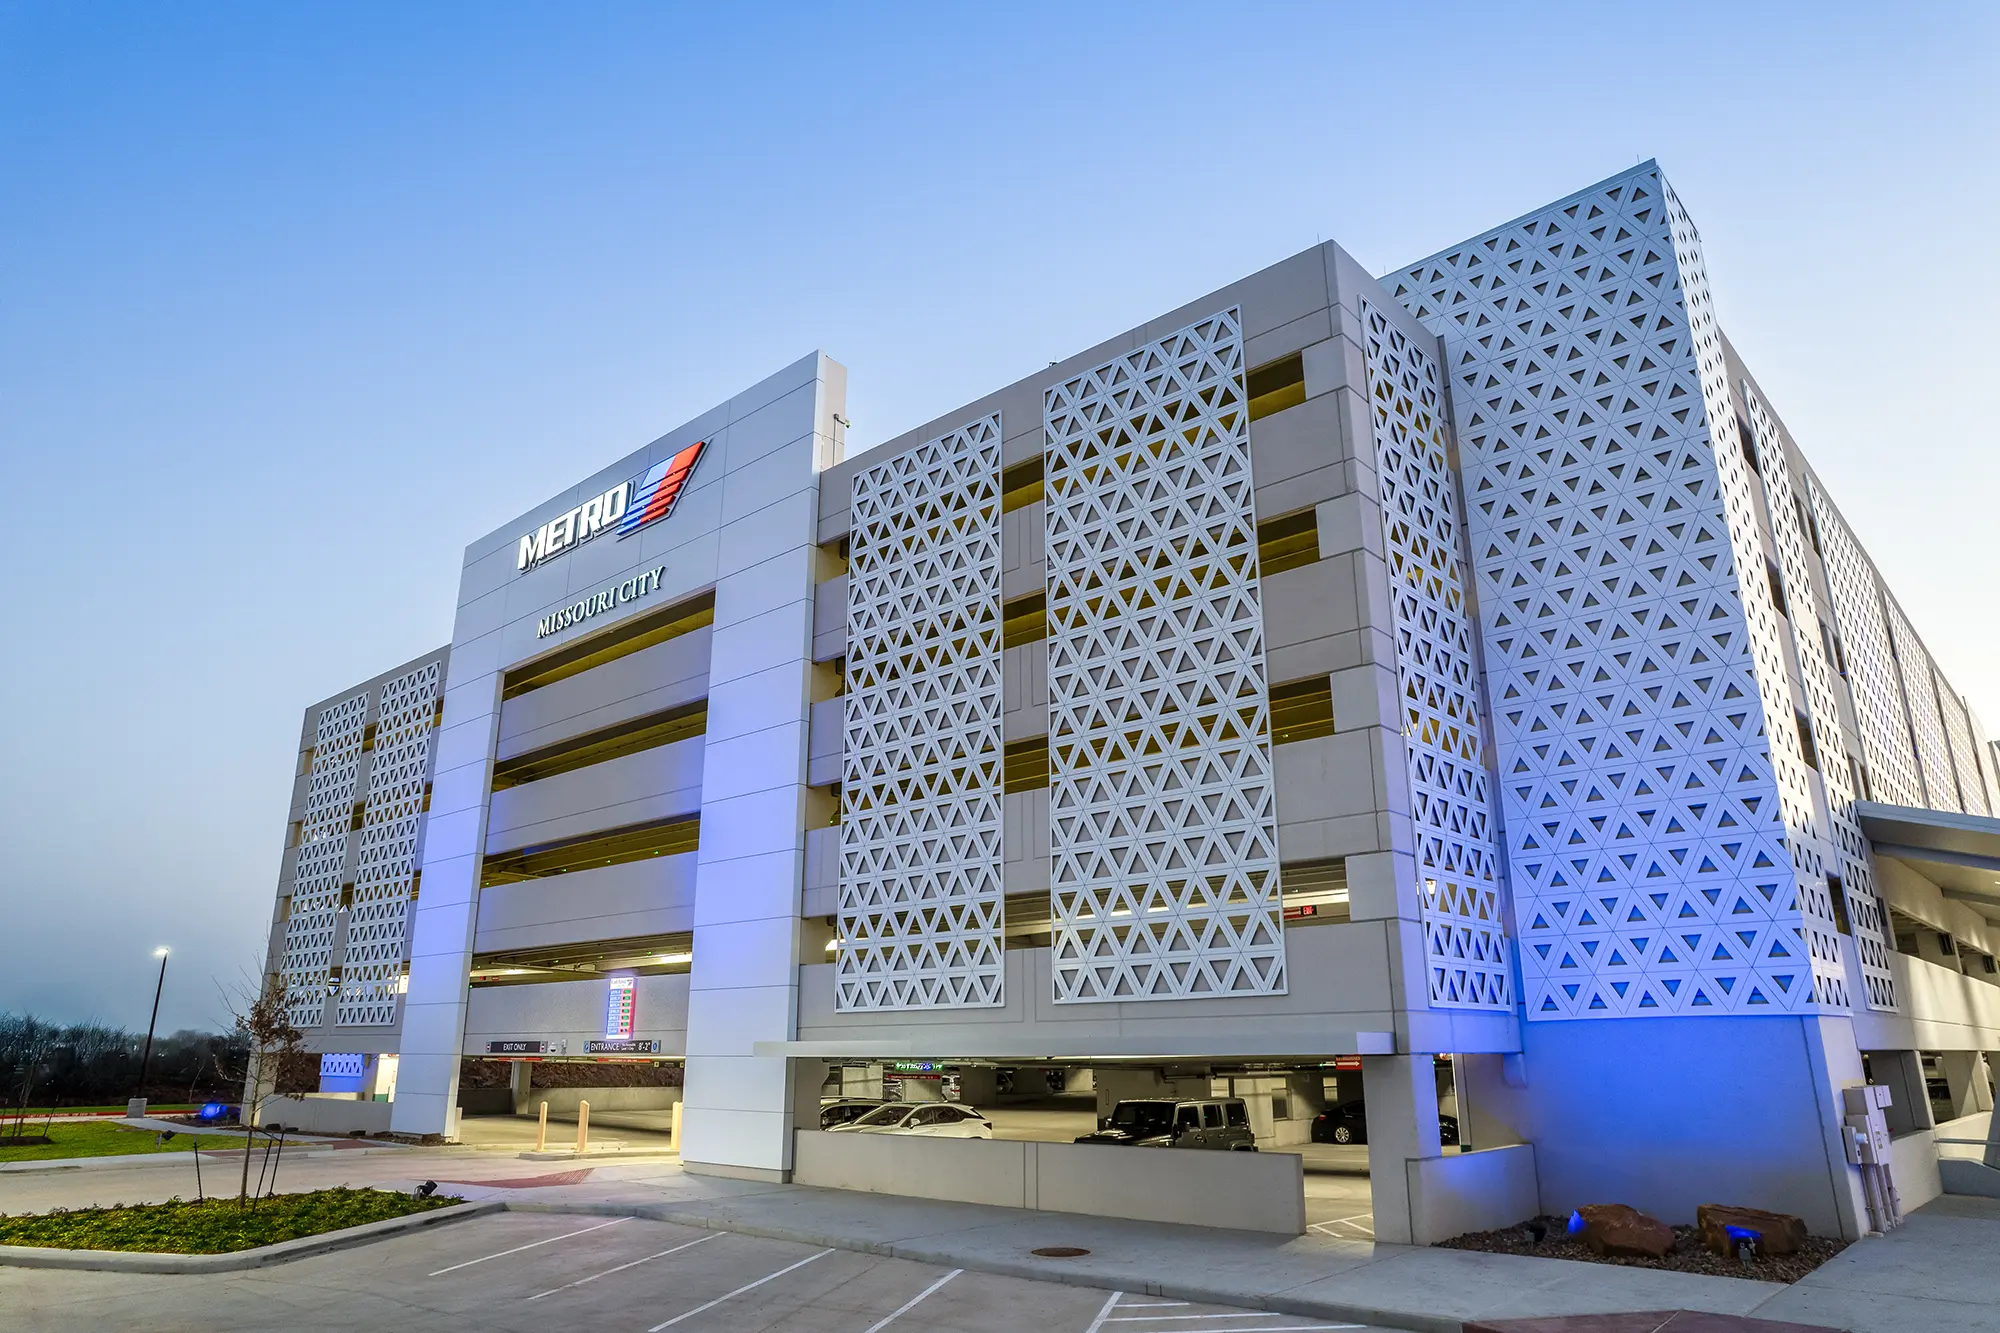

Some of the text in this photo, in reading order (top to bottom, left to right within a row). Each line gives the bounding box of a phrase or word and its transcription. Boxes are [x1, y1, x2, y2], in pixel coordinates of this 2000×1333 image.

[517, 481, 632, 572] METRO
[537, 565, 666, 639] MISSOURI CITY
[503, 1043, 527, 1051] EXIT ONLY
[590, 1042, 620, 1051] ENTRANCE
